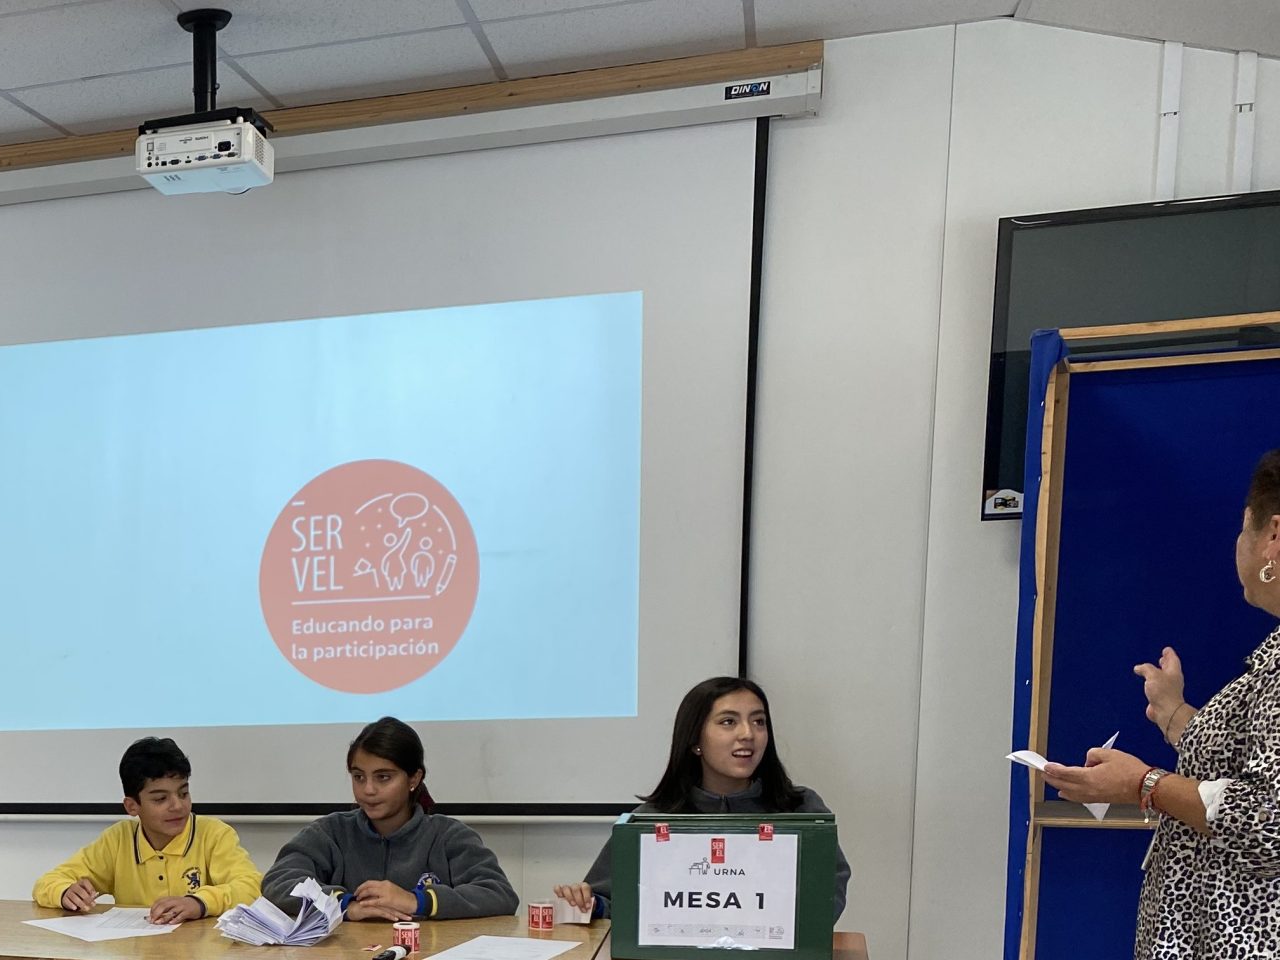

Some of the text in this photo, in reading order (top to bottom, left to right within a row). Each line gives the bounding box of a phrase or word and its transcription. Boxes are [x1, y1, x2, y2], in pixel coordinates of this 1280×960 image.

[291, 514, 343, 552] SER
[291, 555, 344, 592] VEL
[291, 616, 433, 634] Educando para
[291, 638, 439, 662] la participación
[714, 868, 746, 876] URNA
[663, 891, 765, 910] MESA 1
